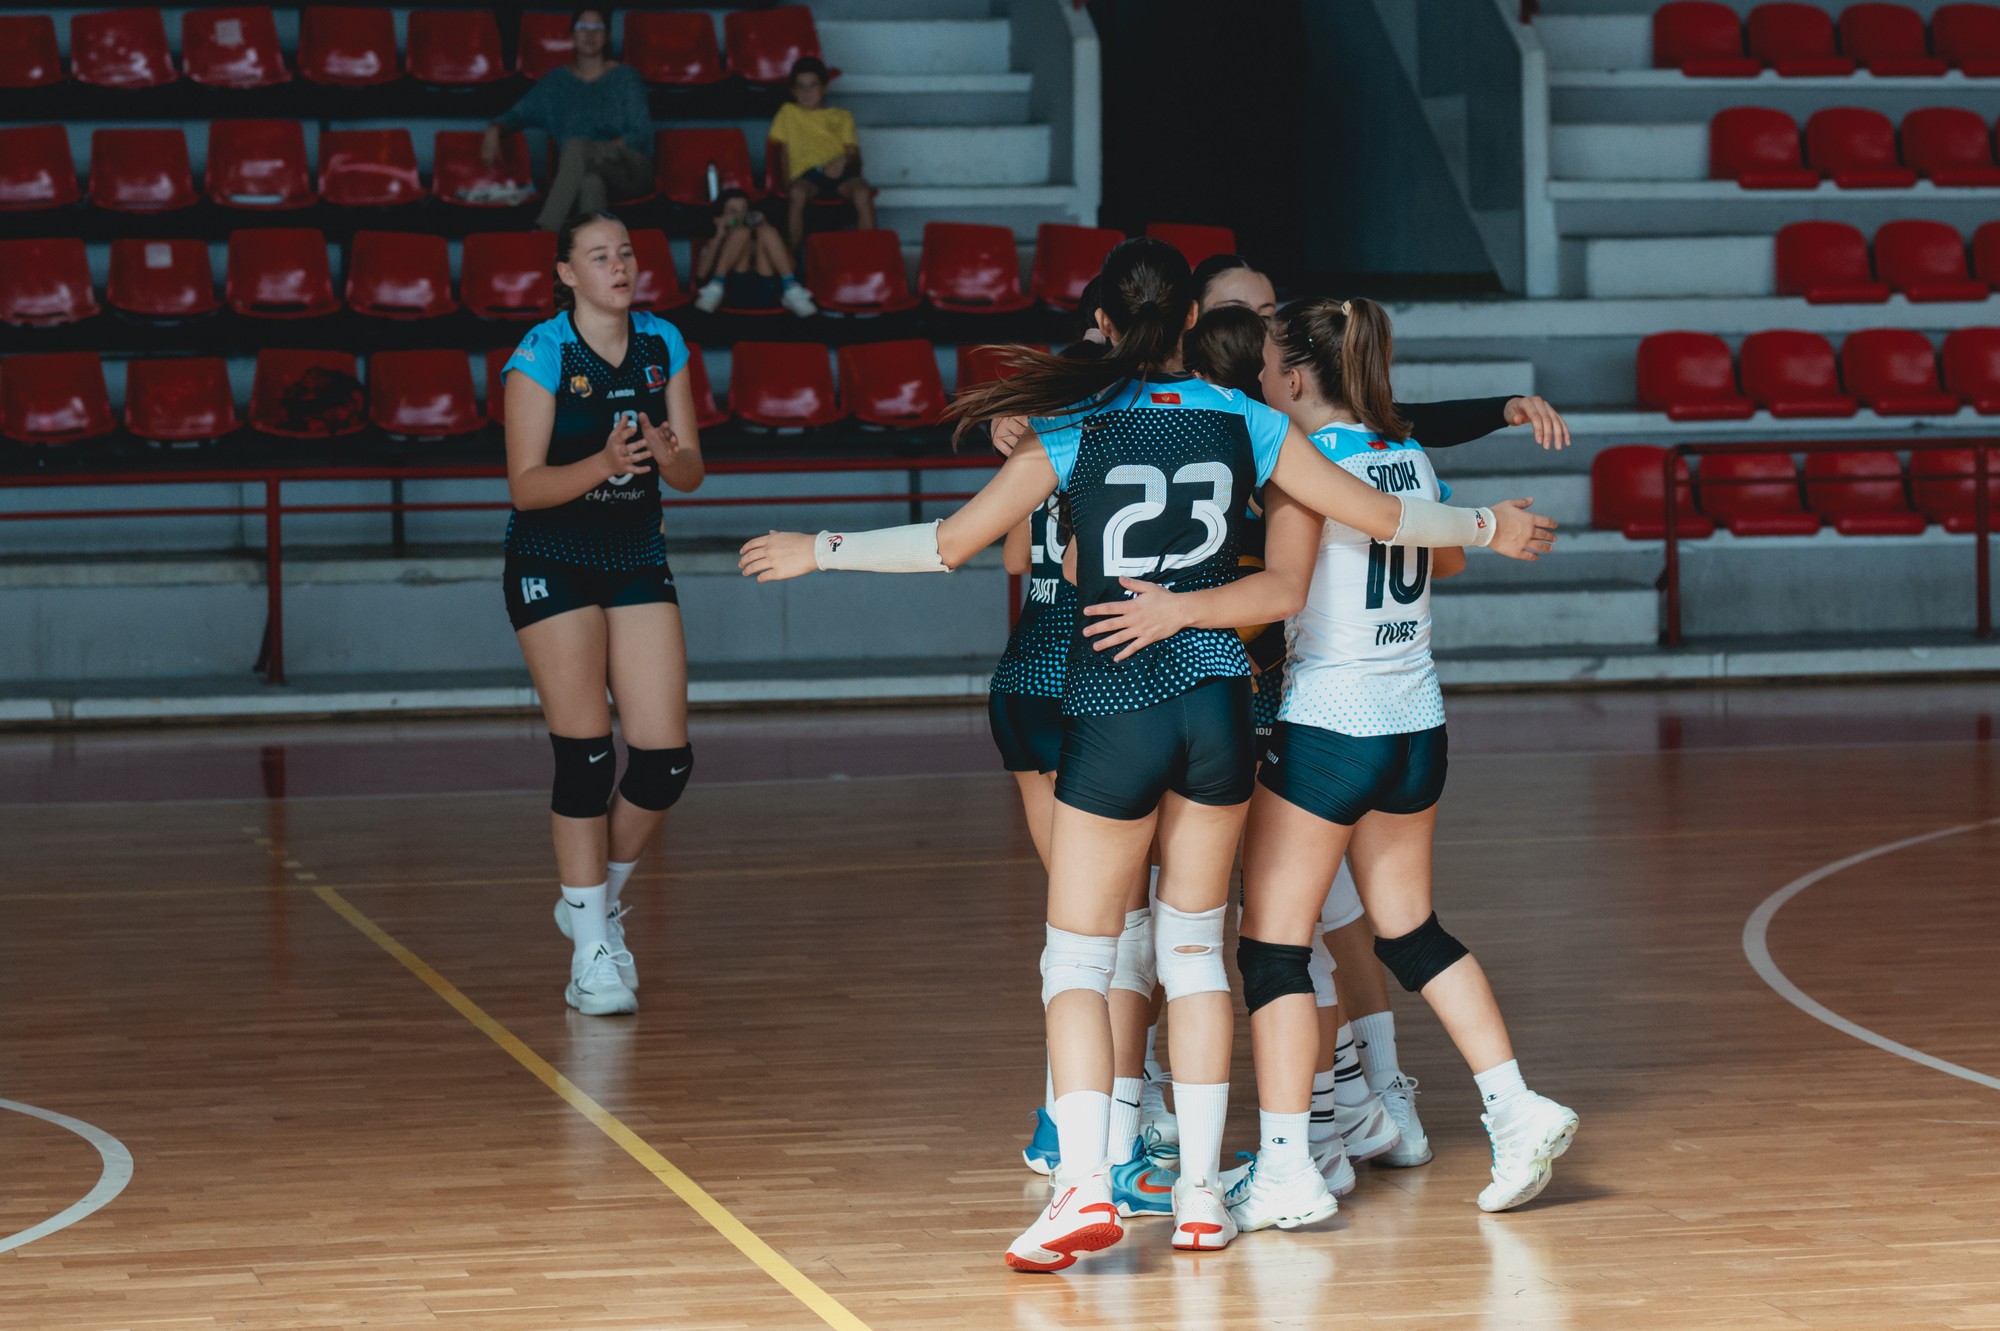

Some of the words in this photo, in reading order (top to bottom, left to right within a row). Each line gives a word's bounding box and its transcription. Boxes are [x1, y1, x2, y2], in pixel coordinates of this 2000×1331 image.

[1367, 460, 1421, 493] SINDIK
[1103, 462, 1233, 577] 23
[1365, 537, 1428, 609] 10
